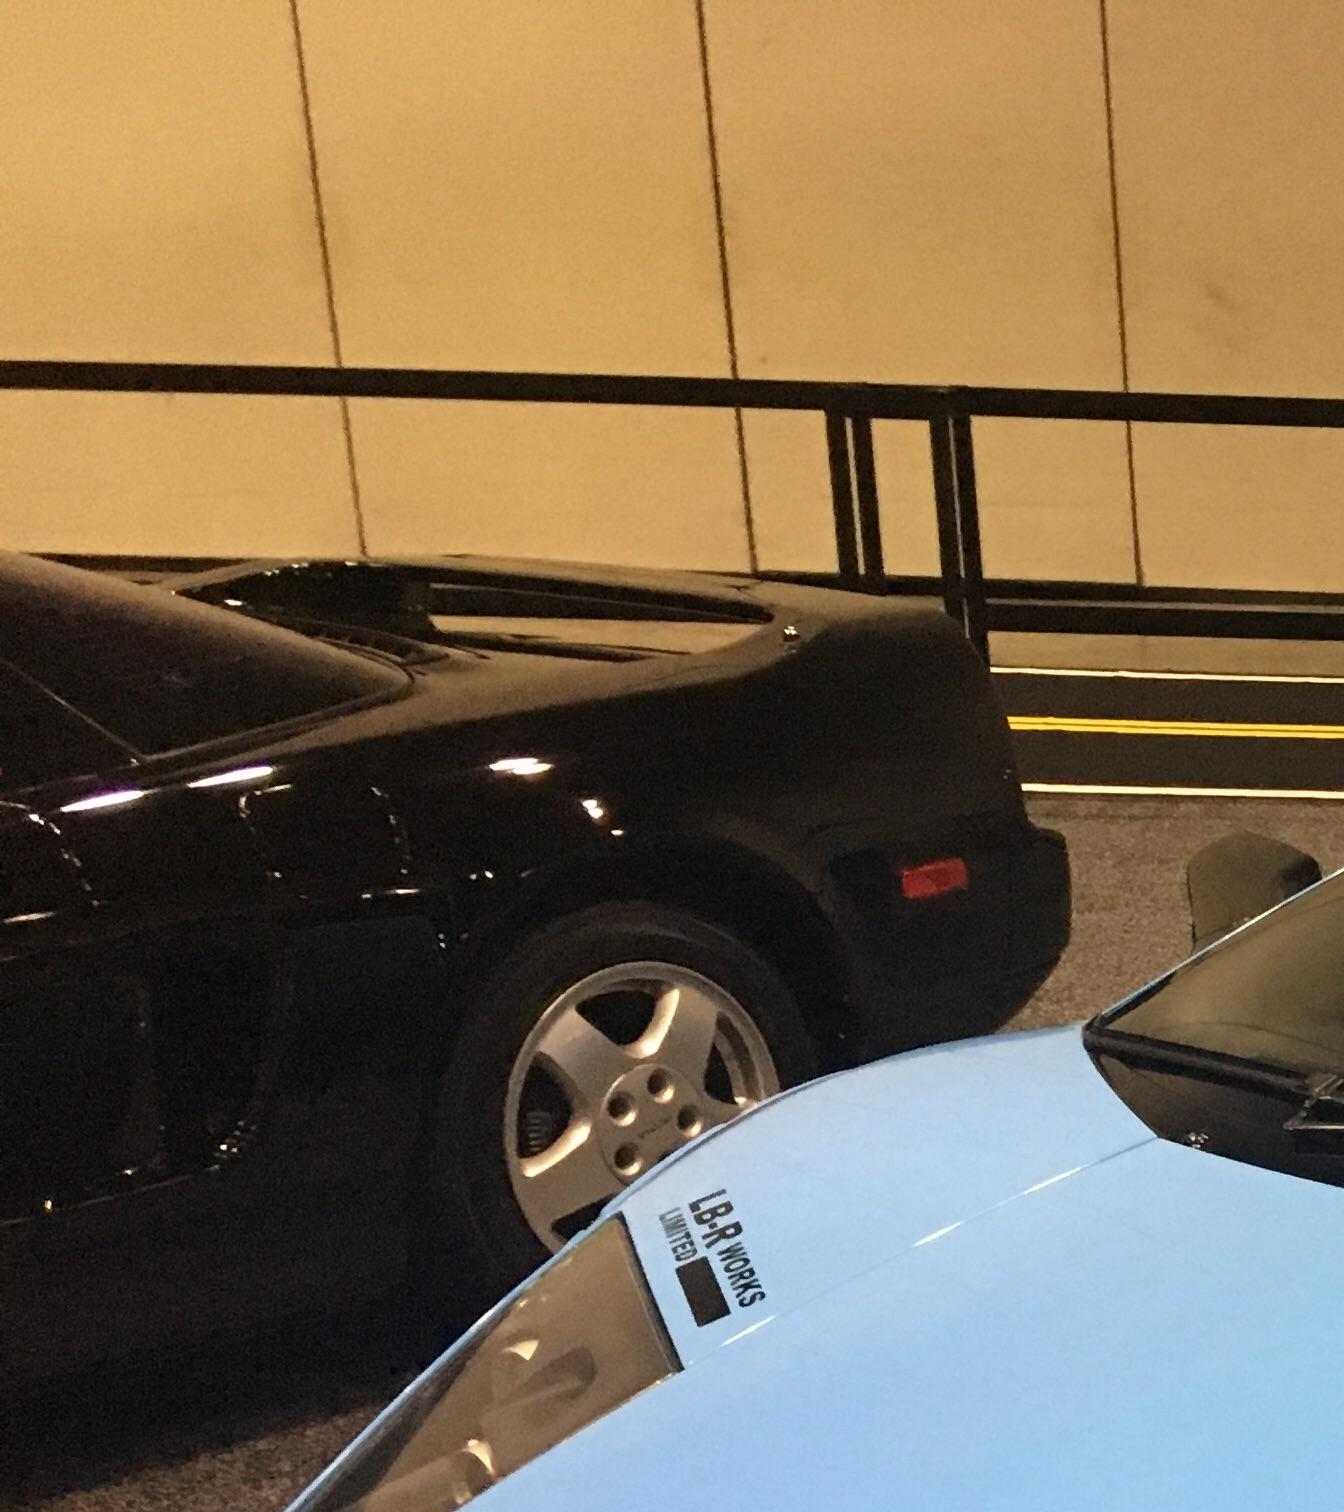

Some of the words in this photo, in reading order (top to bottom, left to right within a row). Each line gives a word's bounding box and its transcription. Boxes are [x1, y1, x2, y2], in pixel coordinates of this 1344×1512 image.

[659, 1207, 698, 1262] LIMITED
[689, 1188, 743, 1249] LB-R
[716, 1241, 766, 1308] WORKS
